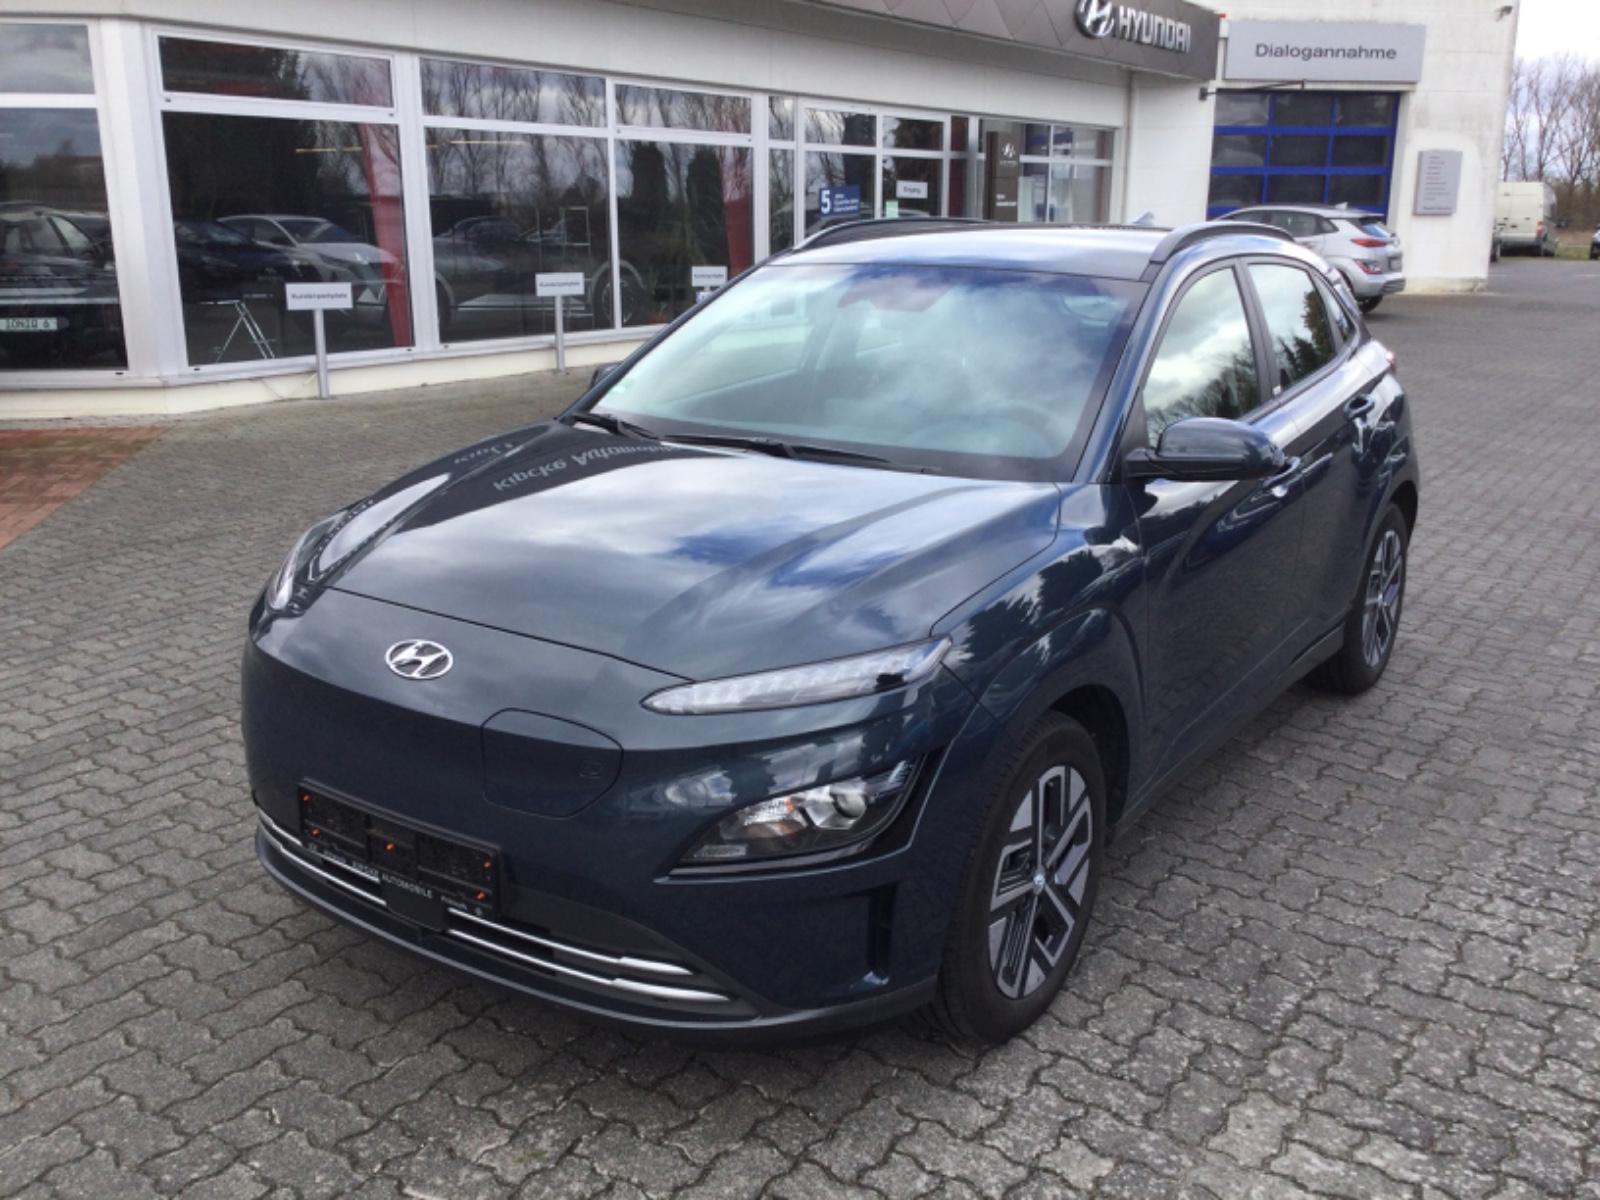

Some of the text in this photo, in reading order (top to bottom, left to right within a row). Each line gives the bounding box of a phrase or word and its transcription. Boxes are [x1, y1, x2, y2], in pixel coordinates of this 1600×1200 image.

[1119, 5, 1191, 53] HYUNDAI
[1255, 43, 1397, 61] Dialogannahme
[821, 189, 831, 214] 5
